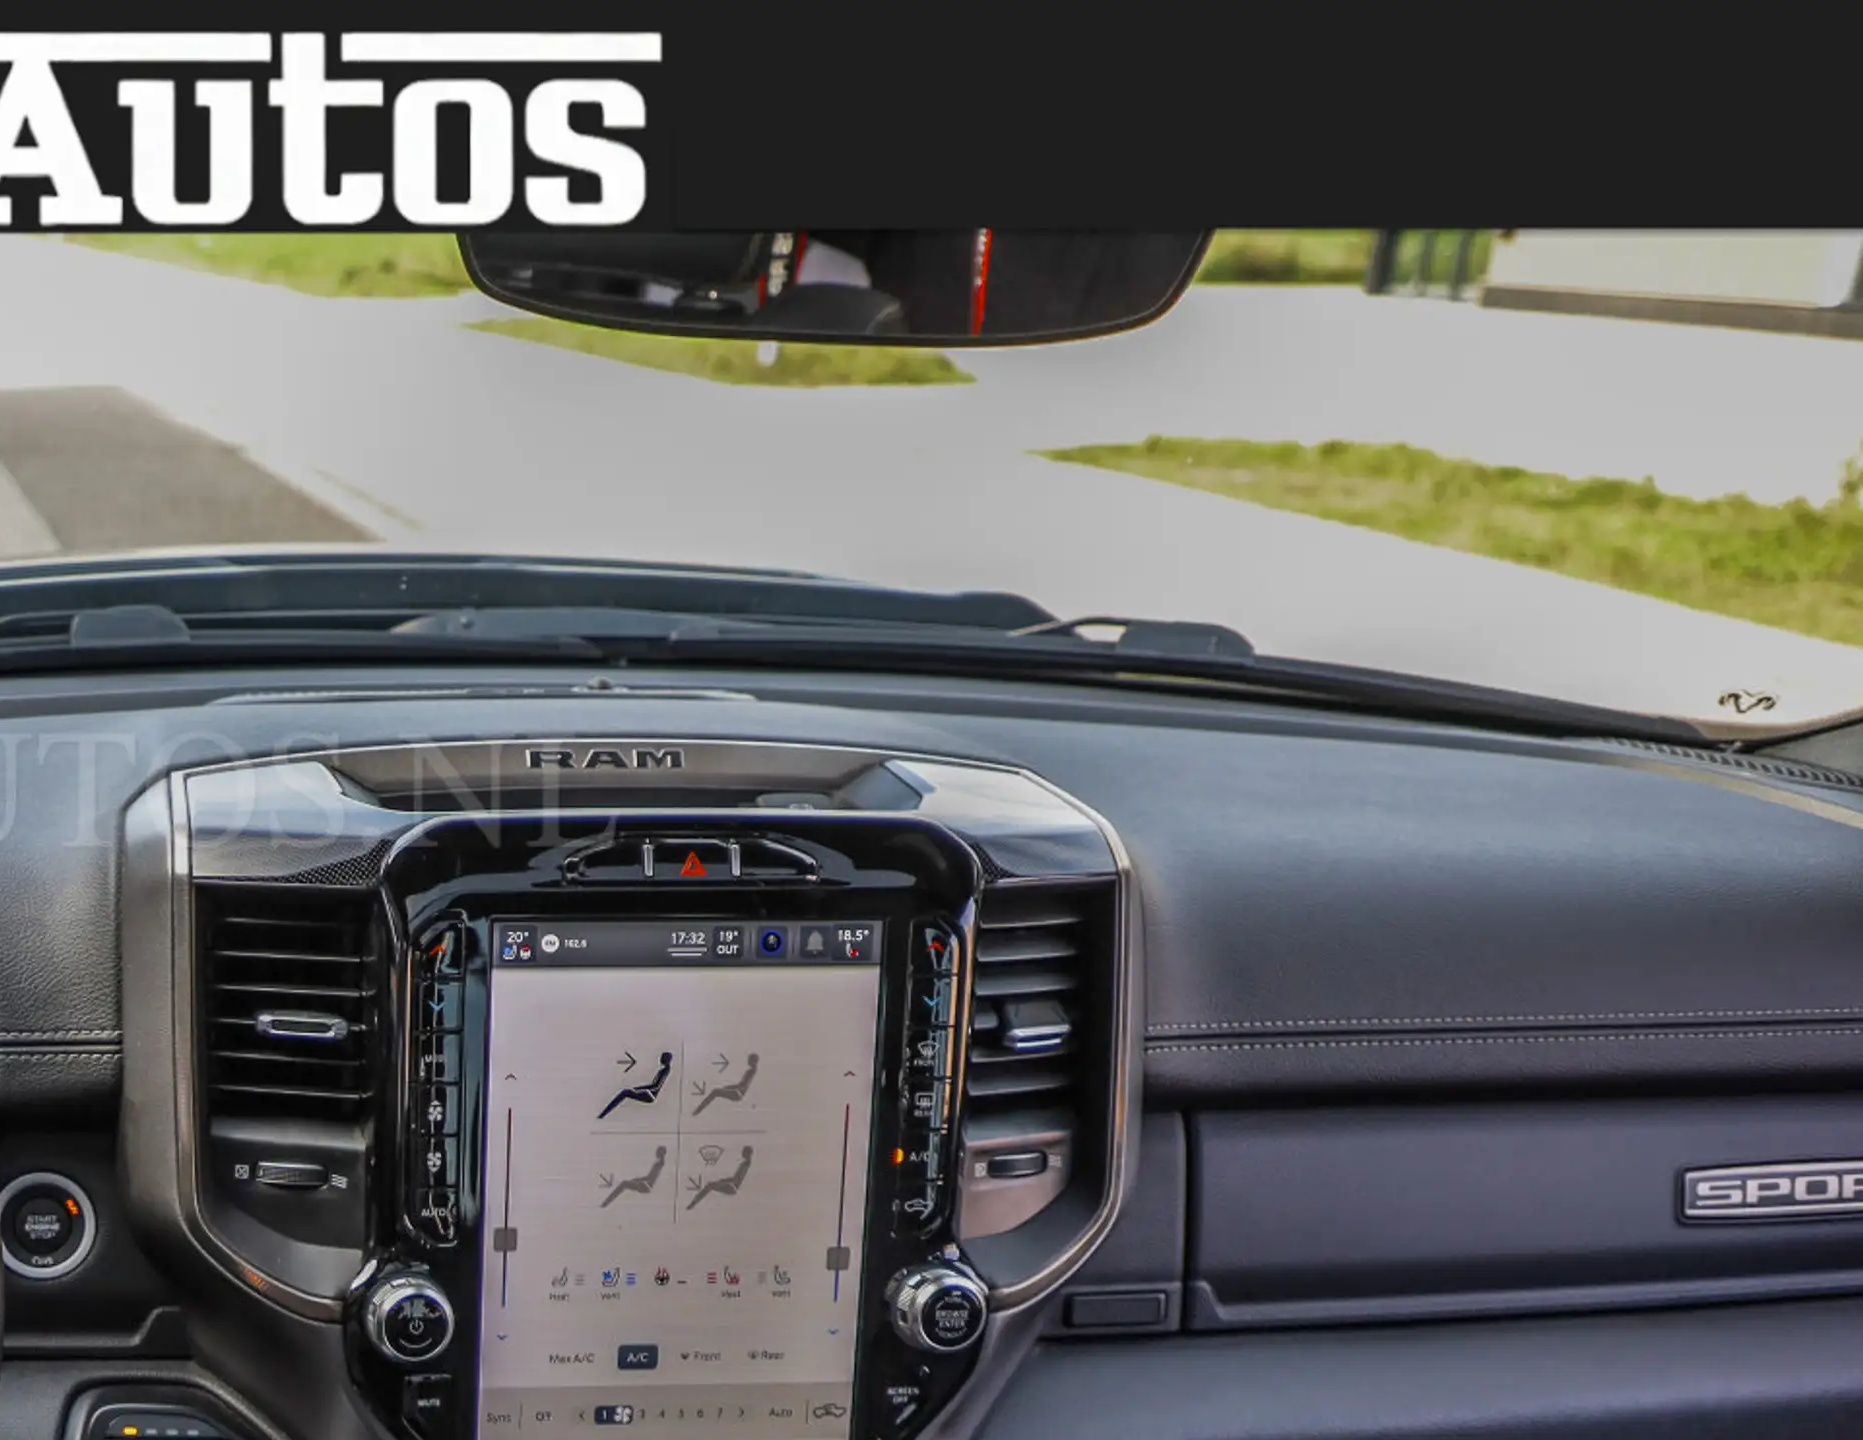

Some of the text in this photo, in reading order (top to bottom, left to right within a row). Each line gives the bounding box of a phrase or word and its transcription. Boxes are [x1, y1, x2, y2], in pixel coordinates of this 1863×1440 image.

[526, 749, 685, 770] RAM
[671, 931, 706, 946] 17:32
[717, 944, 739, 955] OUT
[626, 1352, 649, 1363] A/C
